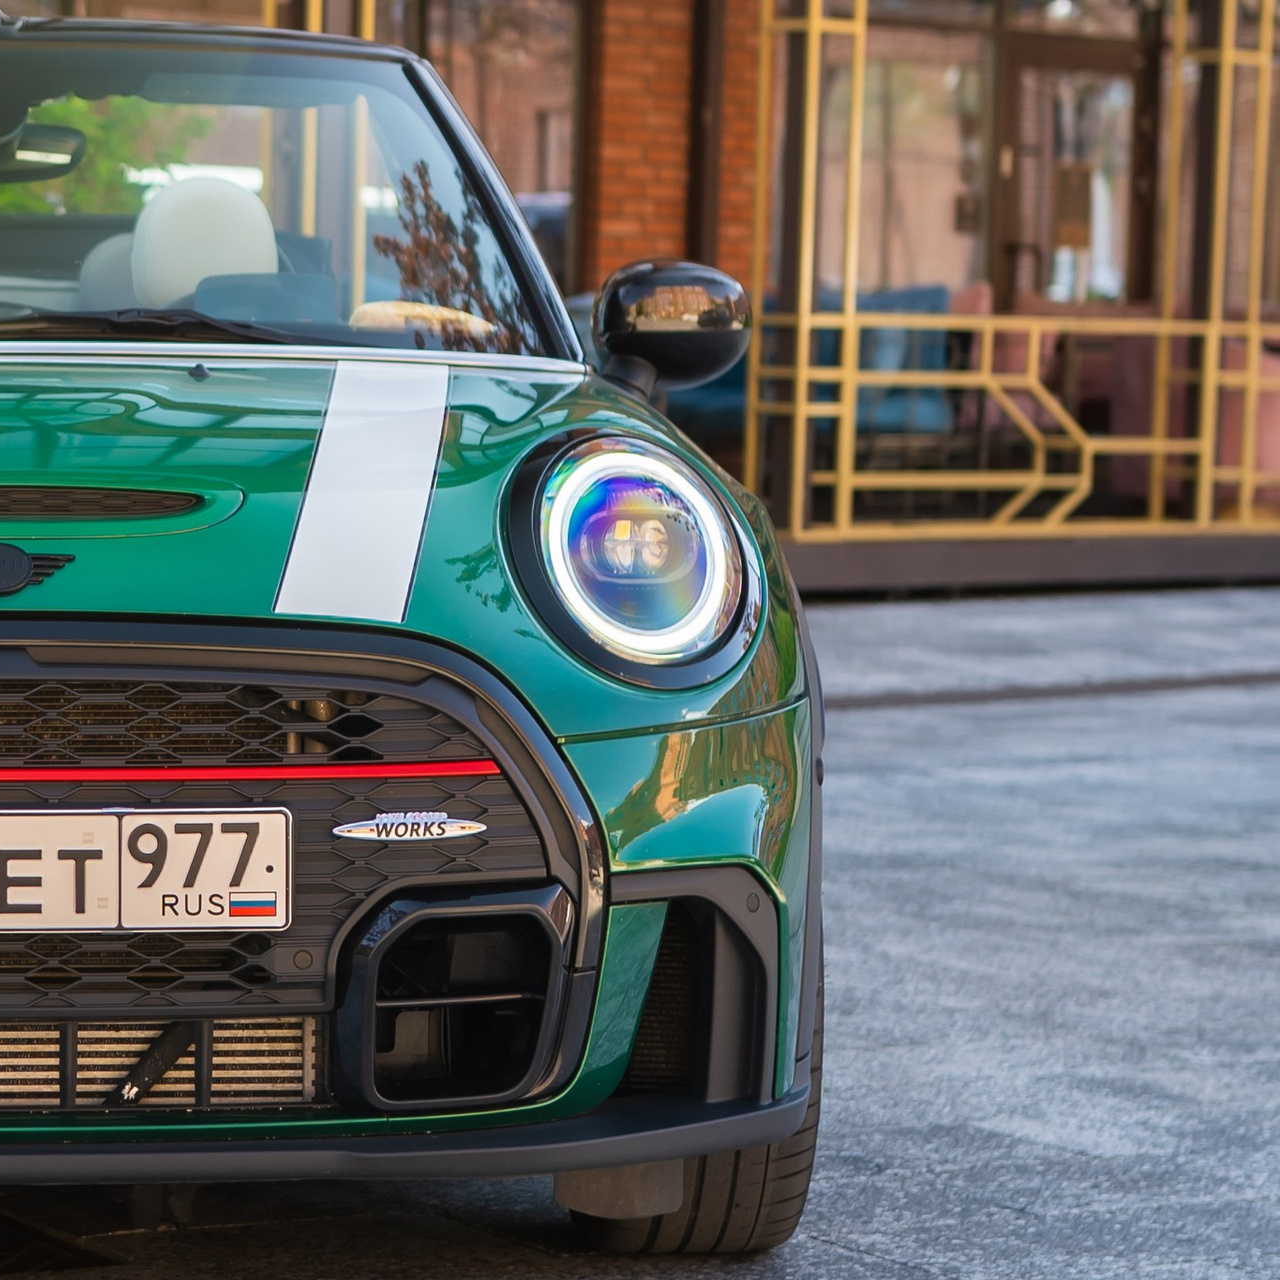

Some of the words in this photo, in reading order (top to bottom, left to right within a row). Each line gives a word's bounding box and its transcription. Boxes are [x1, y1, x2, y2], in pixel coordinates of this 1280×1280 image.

[375, 821, 447, 838] WORKS
[126, 822, 261, 889] 977
[160, 892, 225, 917] RUS
